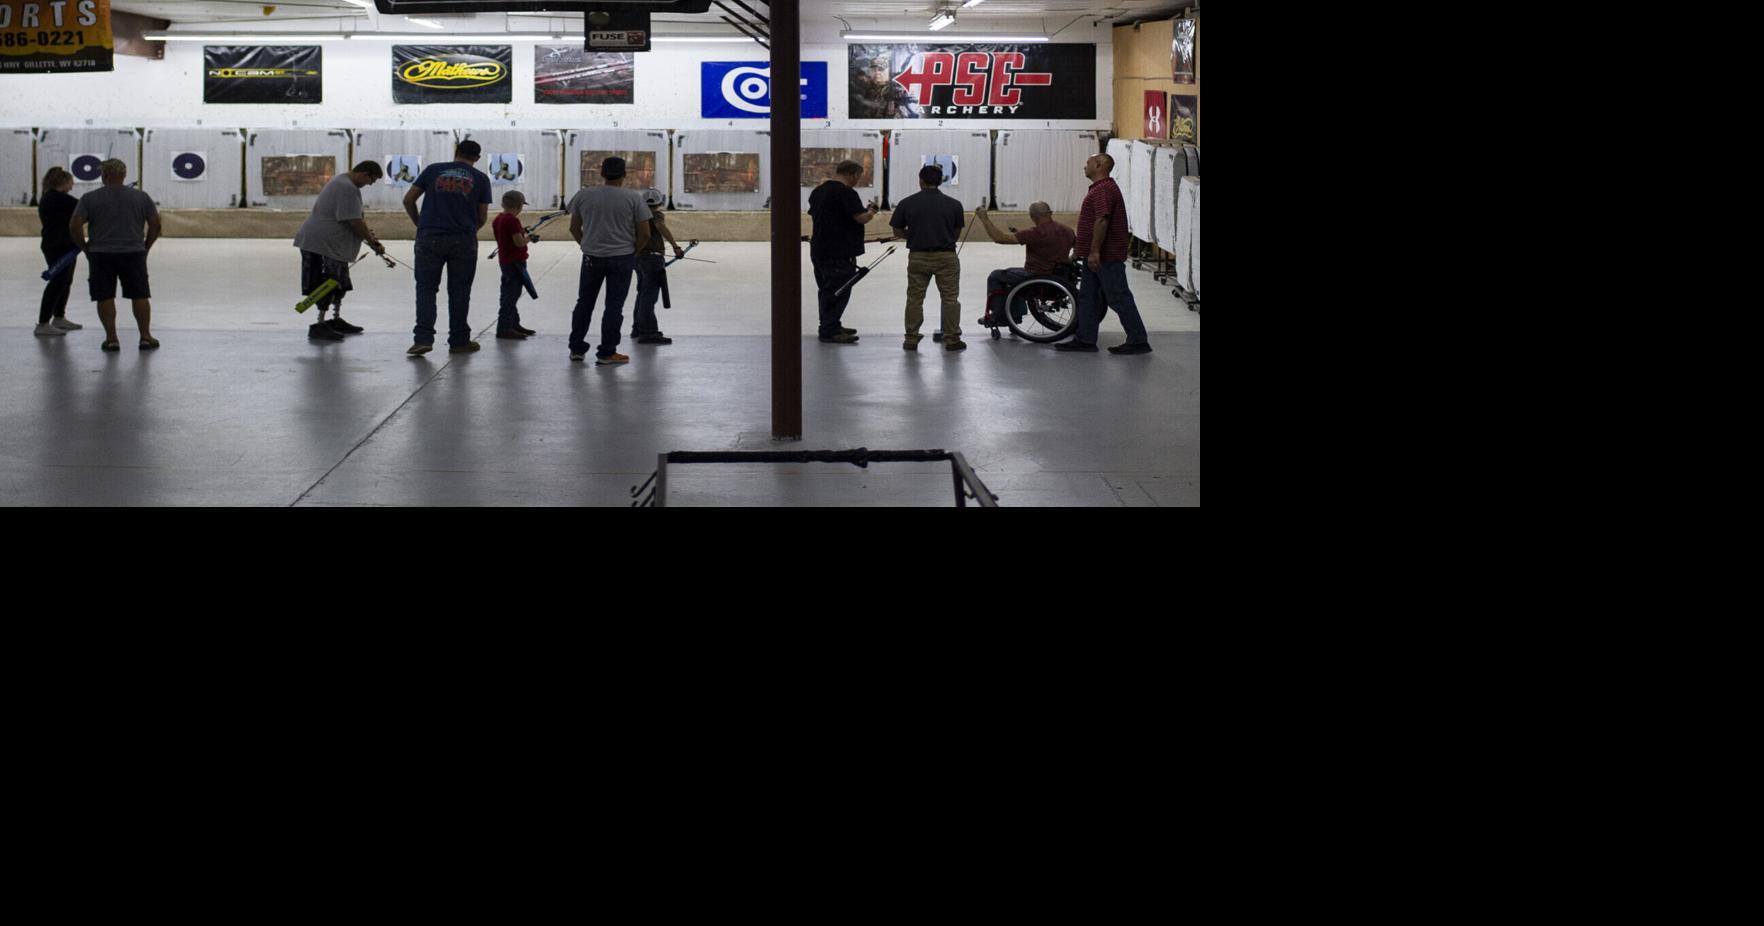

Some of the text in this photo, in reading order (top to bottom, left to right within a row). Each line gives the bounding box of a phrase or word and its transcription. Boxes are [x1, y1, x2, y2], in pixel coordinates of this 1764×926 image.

[0, 31, 84, 47] 86-0221
[404, 60, 500, 82] Mathews
[917, 52, 1026, 107] PSE
[918, 105, 1019, 114] ARCHERY
